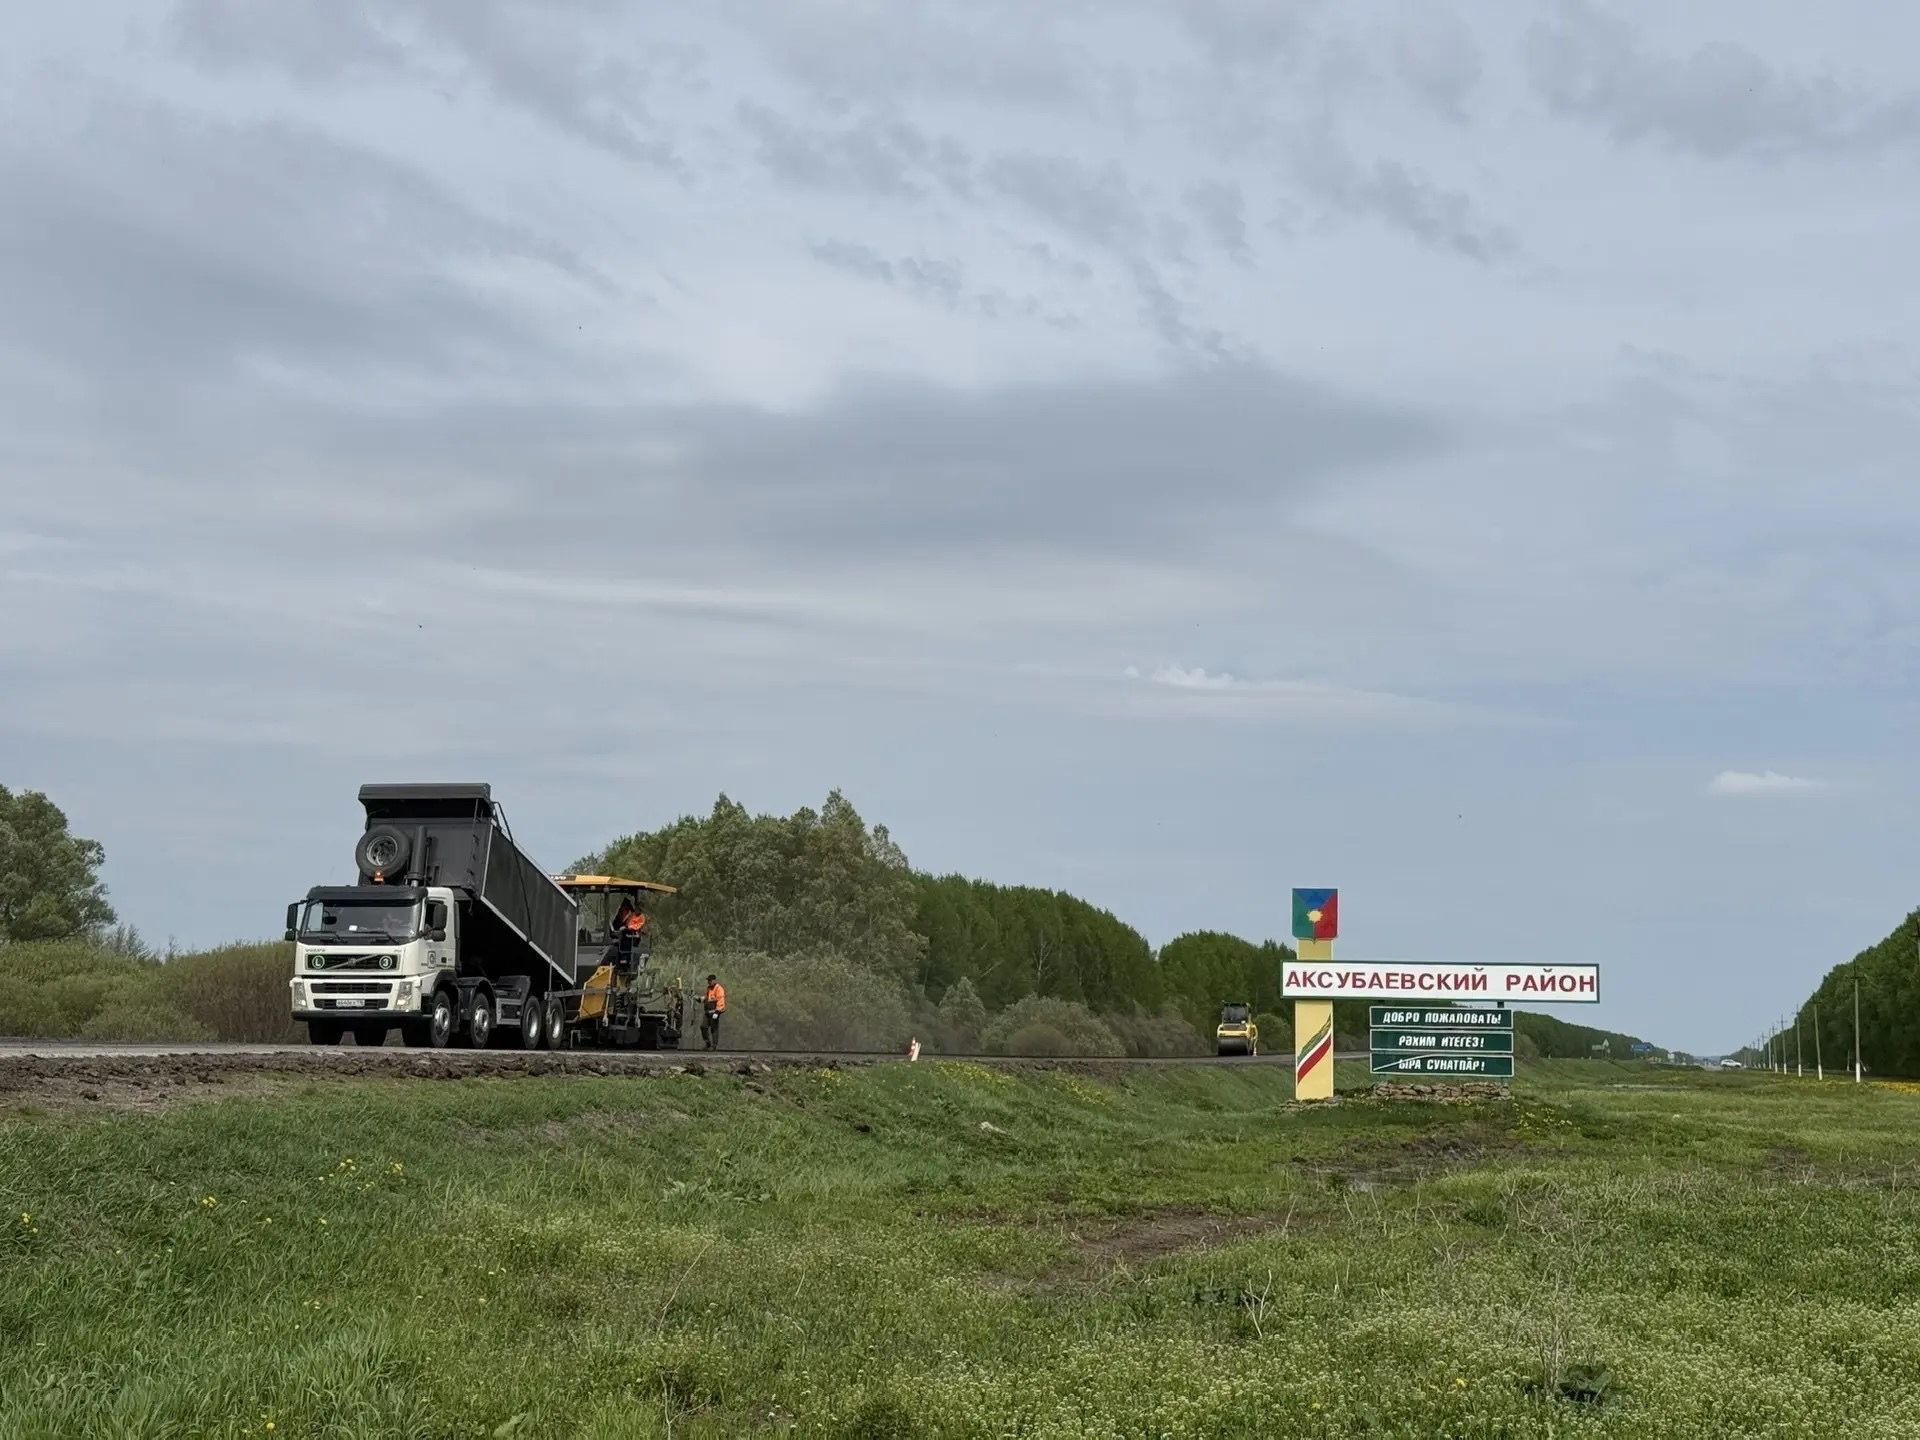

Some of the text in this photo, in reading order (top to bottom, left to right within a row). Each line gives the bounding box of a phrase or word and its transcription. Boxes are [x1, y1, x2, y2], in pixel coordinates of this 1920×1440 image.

[1285, 967, 1595, 992] АКСУБАЕВСКИЙ РАЙОН
[1382, 1011, 1420, 1024] ДОБРО
